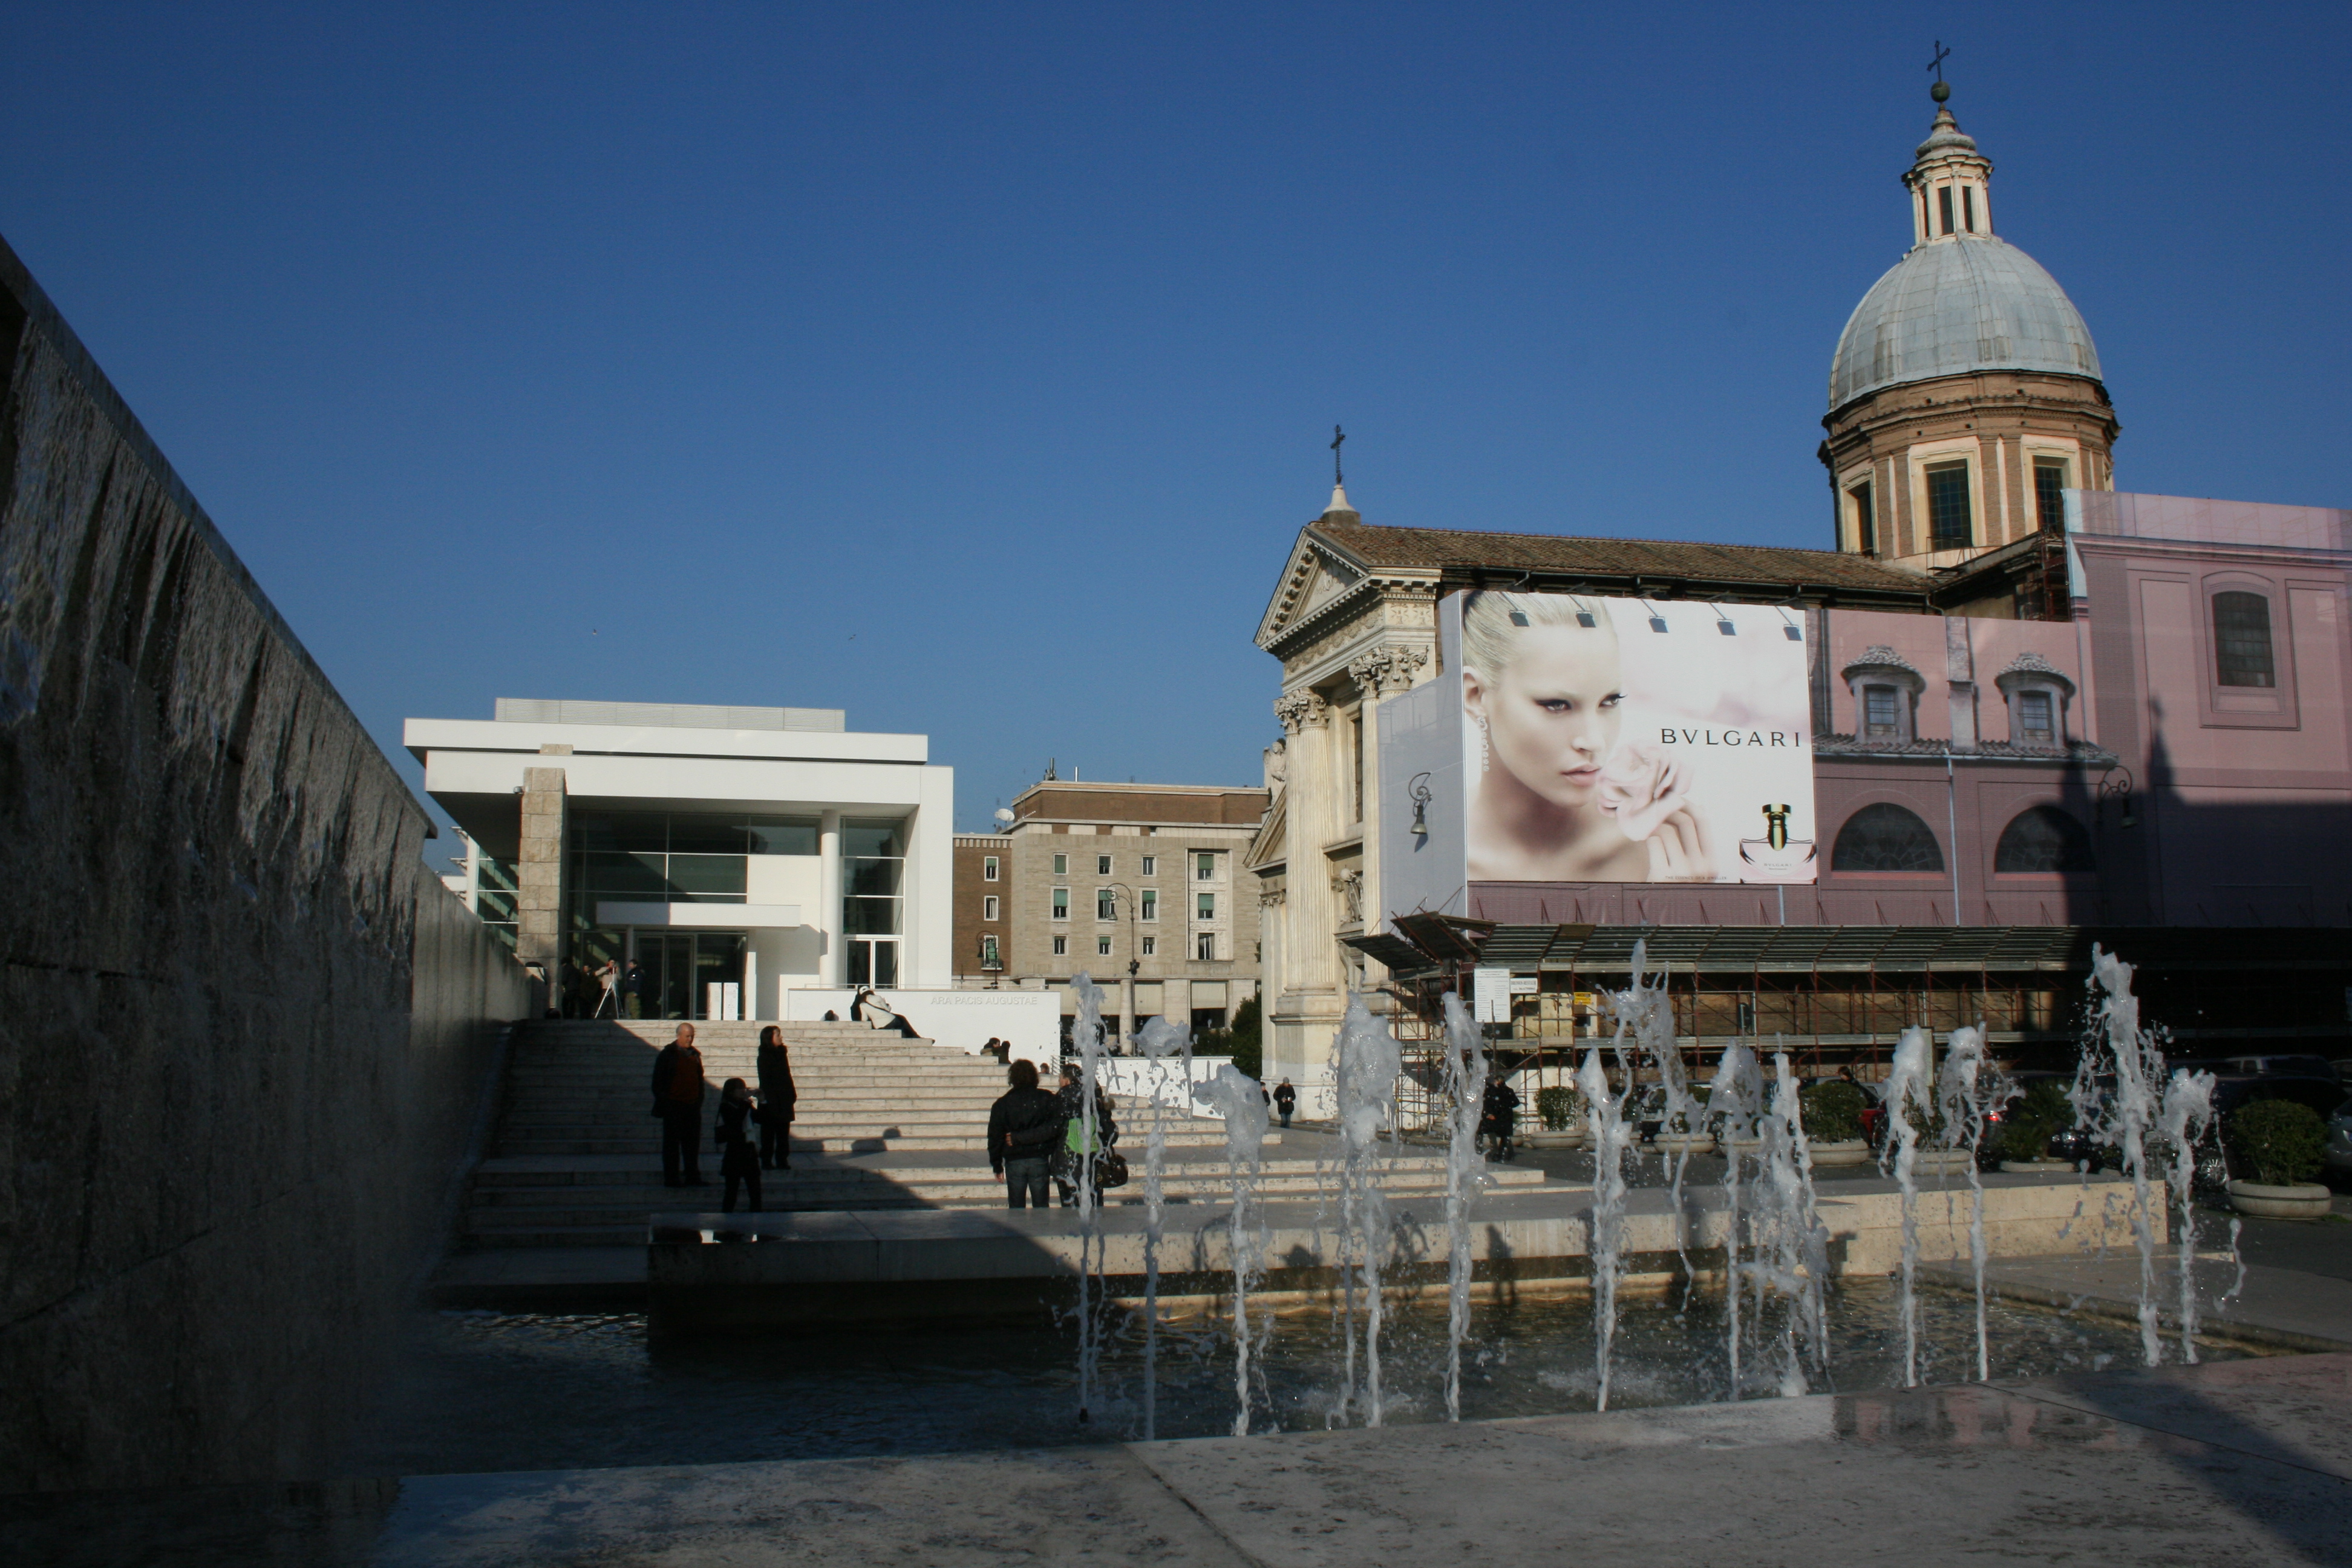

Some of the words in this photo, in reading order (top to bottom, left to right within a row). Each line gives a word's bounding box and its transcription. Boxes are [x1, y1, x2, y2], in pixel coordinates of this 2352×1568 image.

[1660, 728, 1800, 747] BVLGARI
[930, 996, 952, 1005] ARA
[955, 996, 982, 1005] PACIS
[985, 996, 1038, 1005] AUGUSTAE
